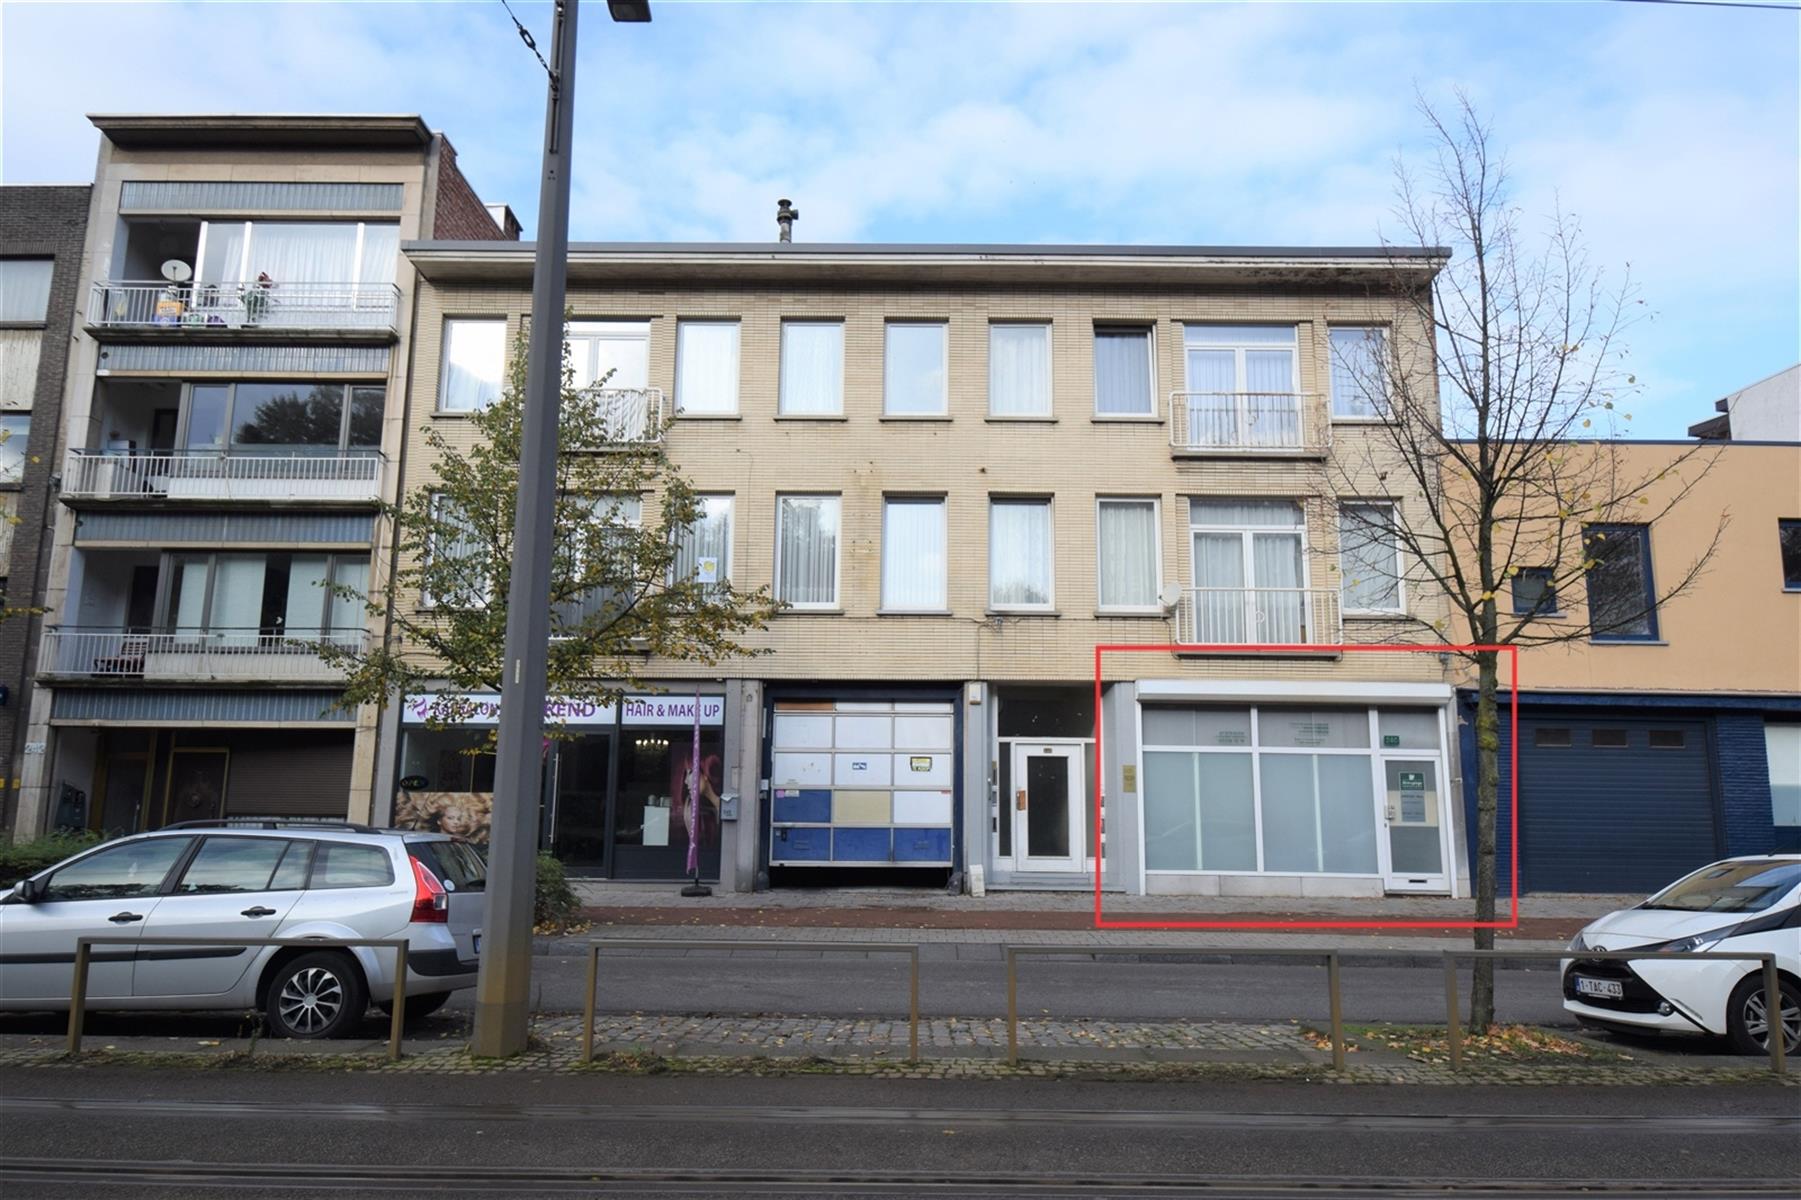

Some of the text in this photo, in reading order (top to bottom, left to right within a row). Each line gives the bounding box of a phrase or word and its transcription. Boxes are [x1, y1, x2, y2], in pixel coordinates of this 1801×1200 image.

[544, 702, 596, 717] REND
[626, 704, 720, 717] HAIR & MAK UP
[1581, 980, 1621, 995] 1-TAC-433
